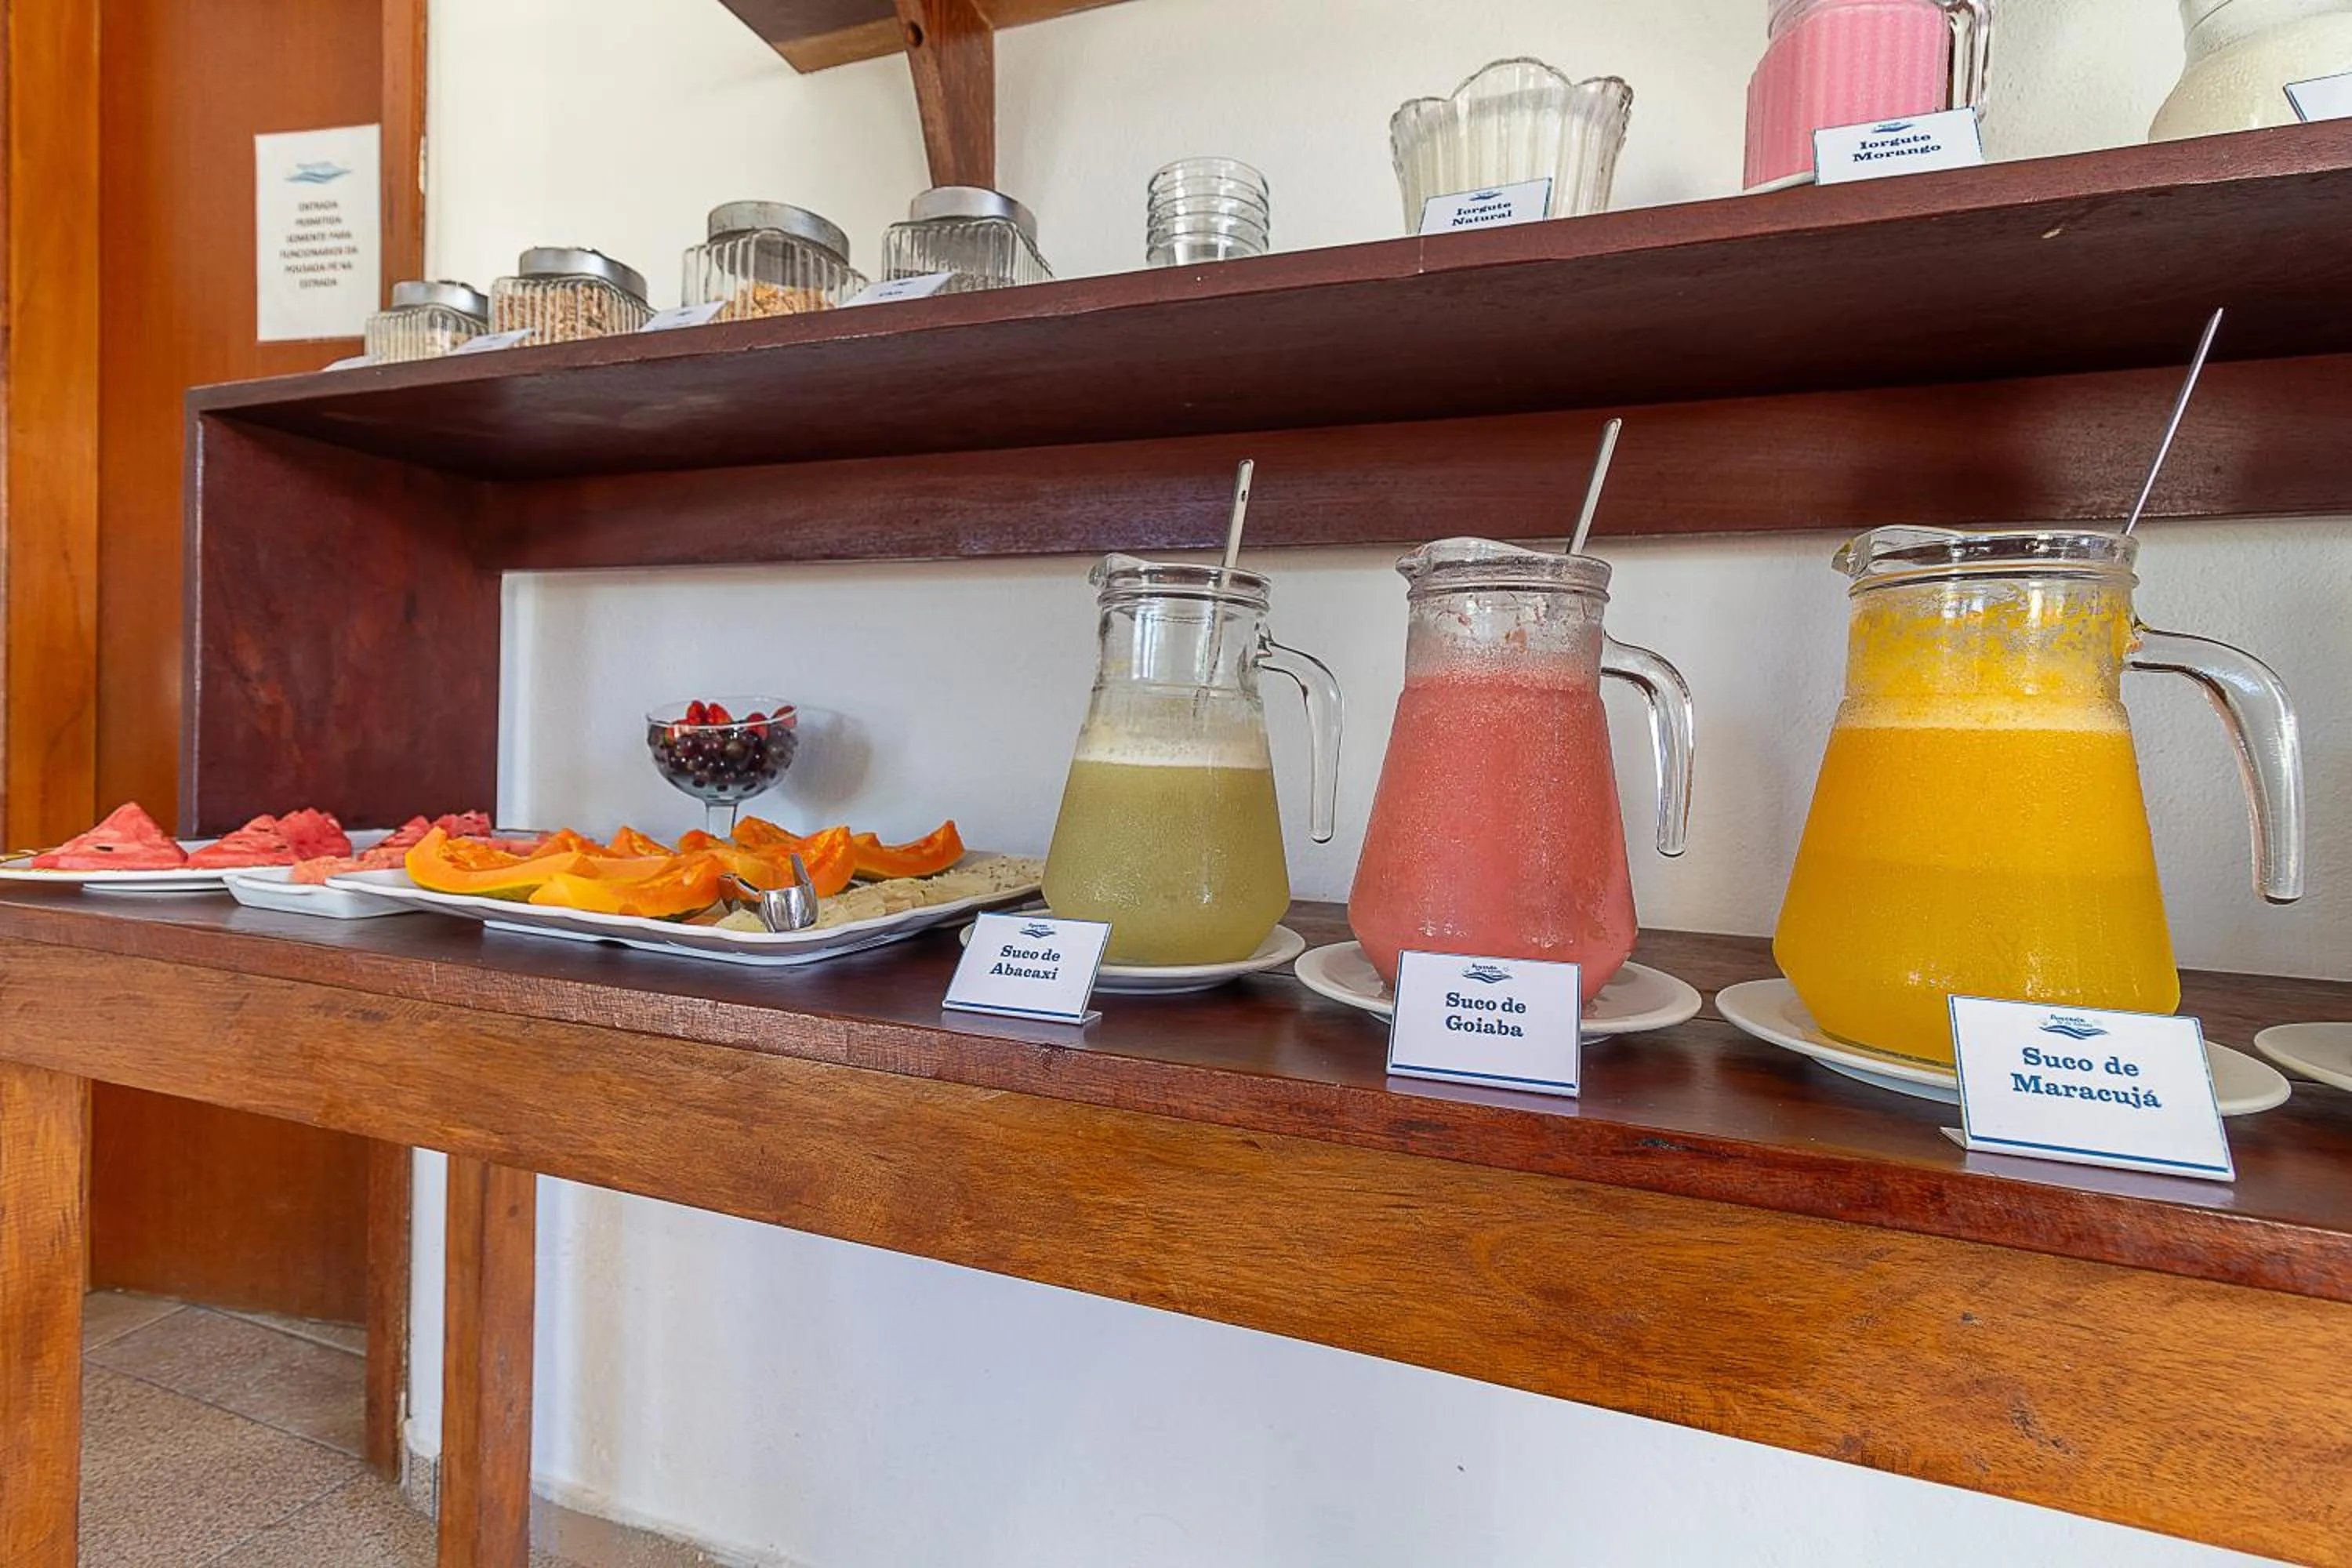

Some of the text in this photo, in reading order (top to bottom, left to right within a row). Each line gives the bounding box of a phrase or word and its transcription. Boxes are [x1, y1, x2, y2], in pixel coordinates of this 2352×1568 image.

[1853, 143, 1942, 162] Morango
[1452, 210, 1512, 226] Natural
[1000, 945, 1060, 962] Suco de
[989, 963, 1059, 980] Abacaxi
[1445, 992, 1526, 1014] Suco de
[1445, 1015, 1523, 1037] Goiaba
[2022, 1047, 2139, 1076] Suco de
[2010, 1073, 2162, 1109] Maracujá
